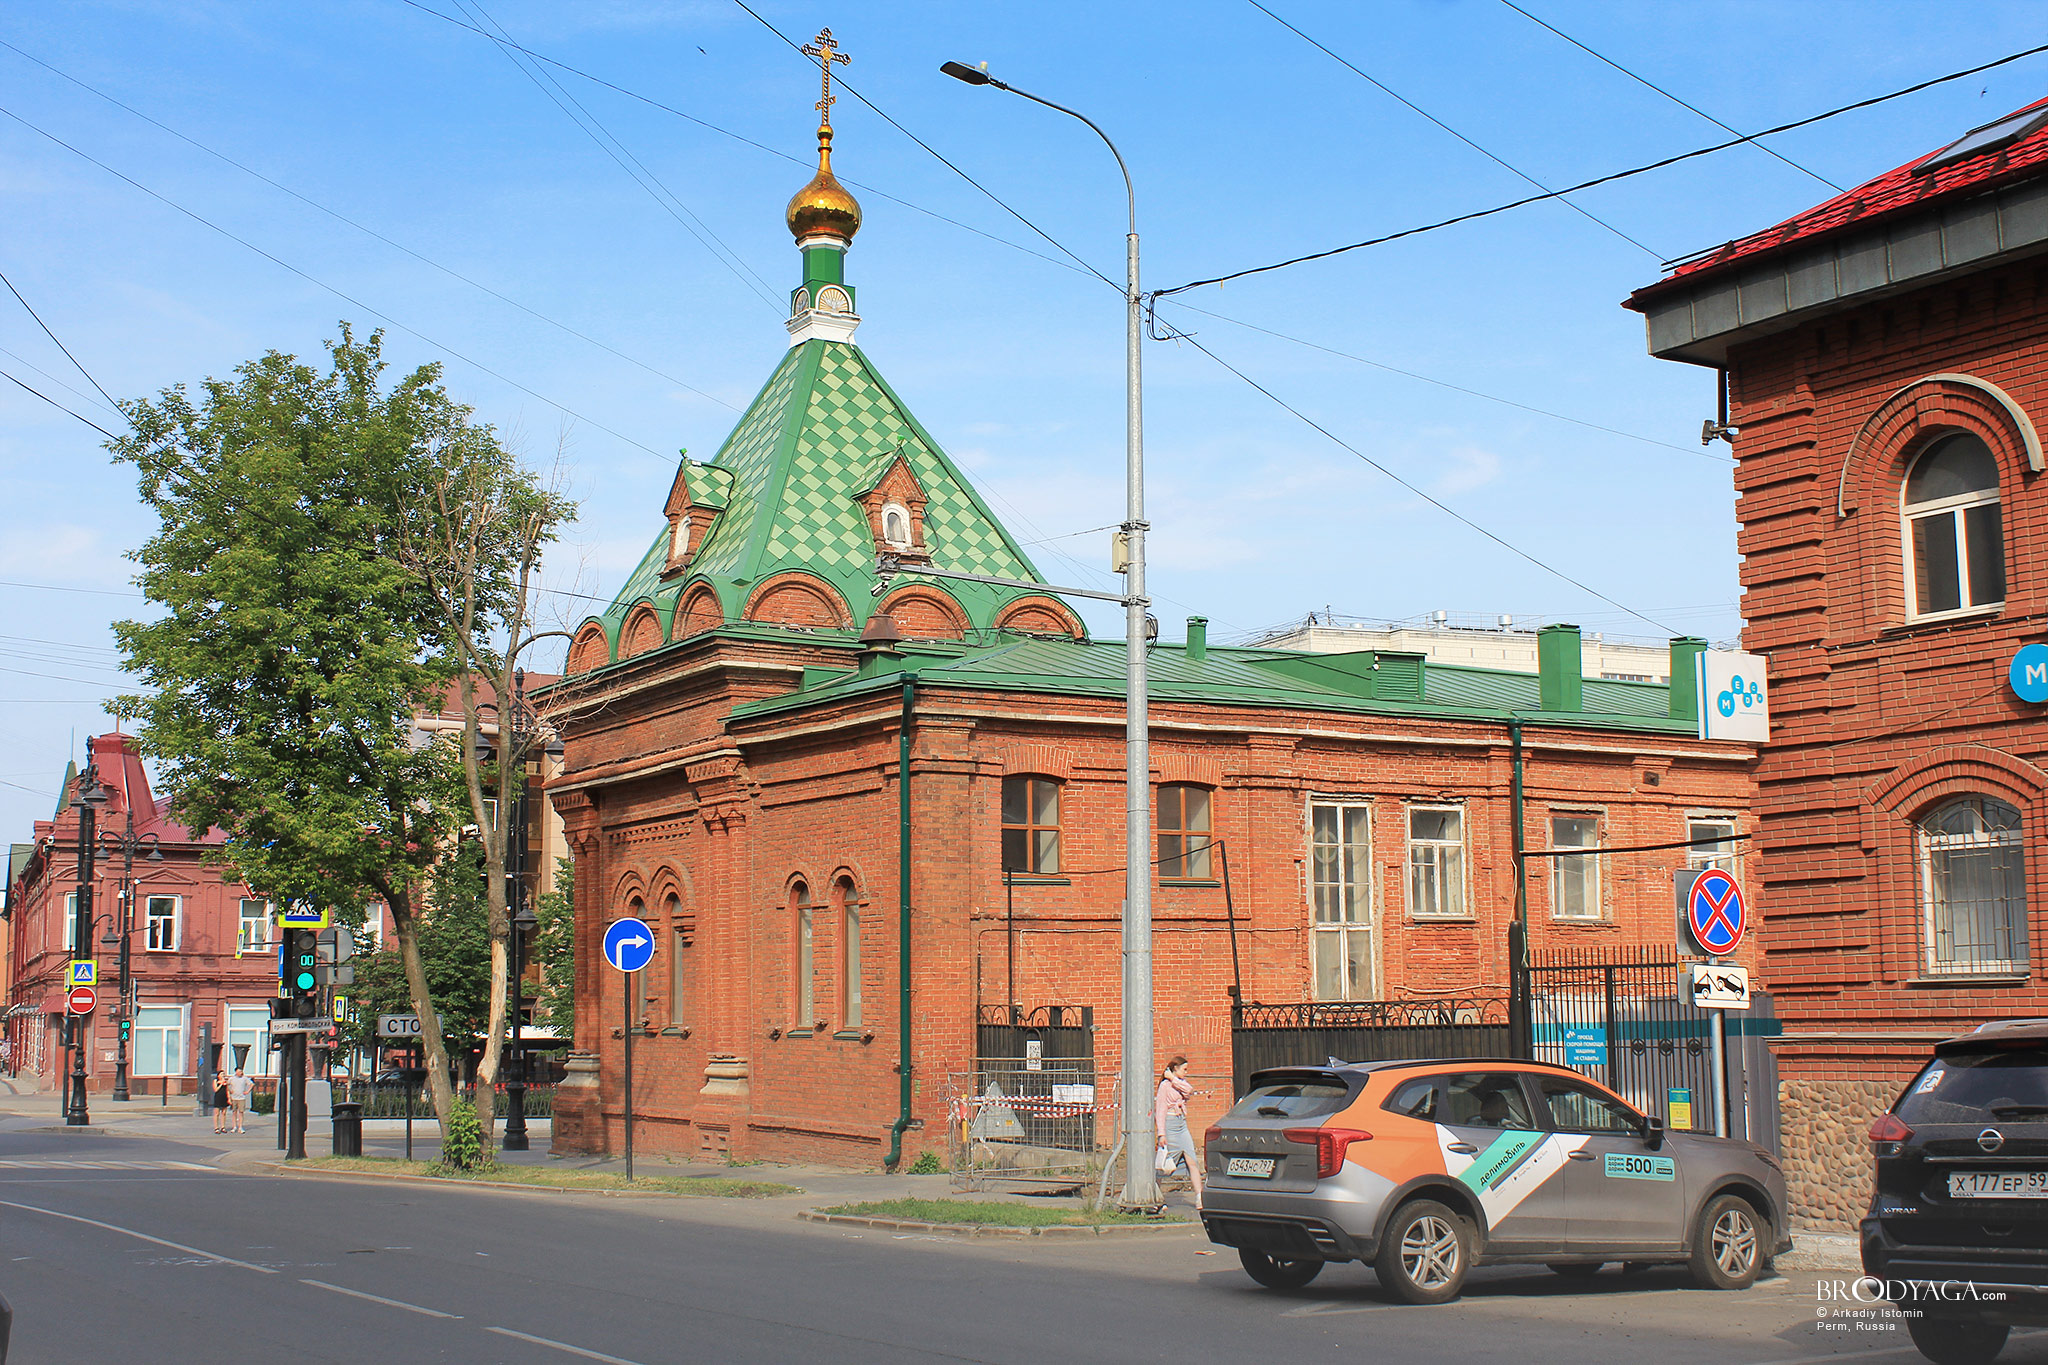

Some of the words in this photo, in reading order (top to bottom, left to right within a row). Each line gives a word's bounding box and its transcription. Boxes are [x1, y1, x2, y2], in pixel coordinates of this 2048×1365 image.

[387, 1019, 421, 1034] СТО
[1480, 1141, 1526, 1186] делимобиль
[1625, 1157, 1652, 1174] 500
